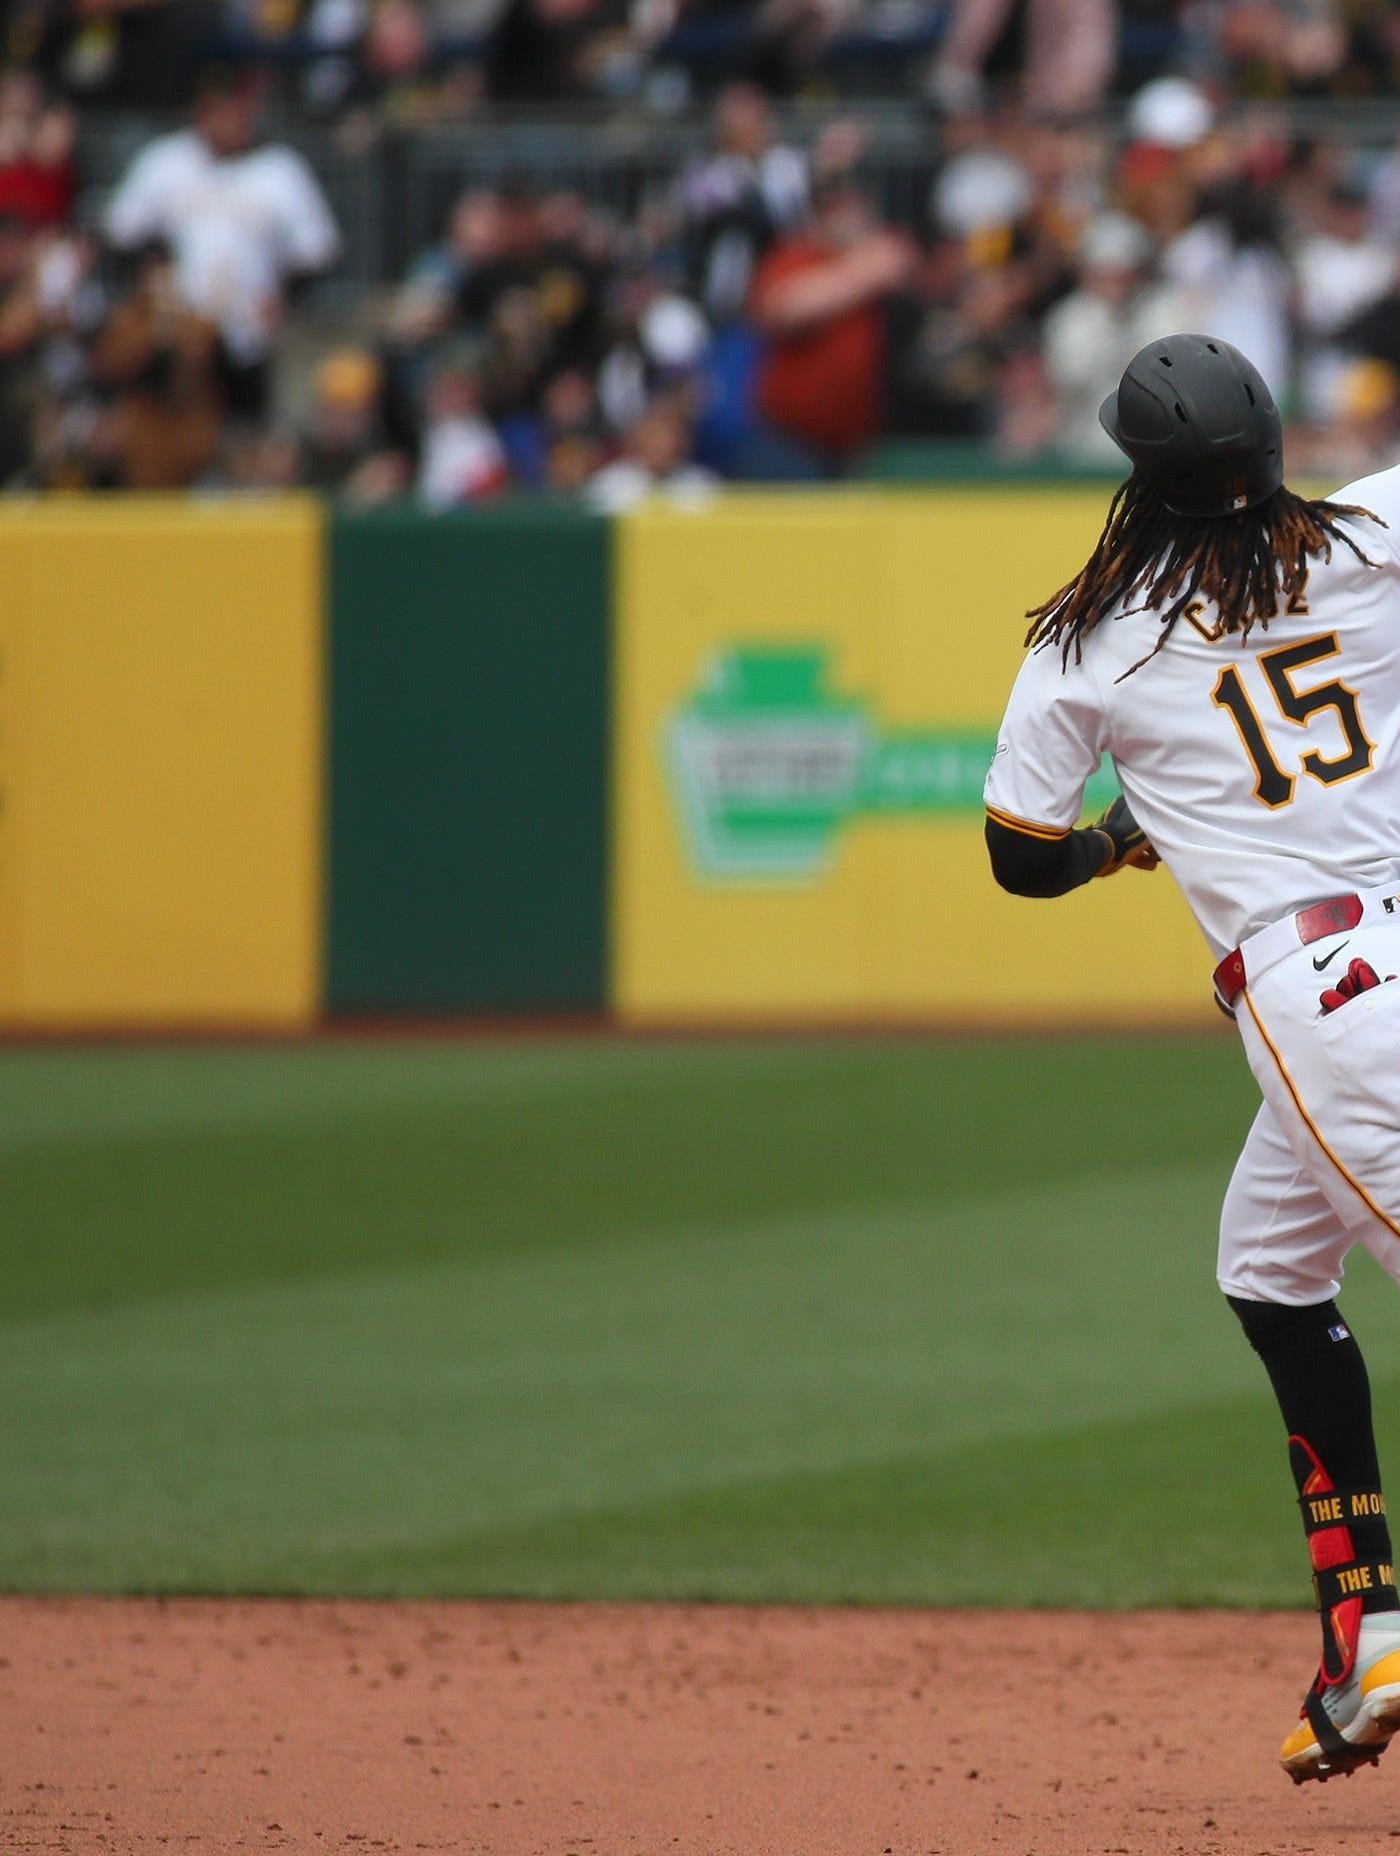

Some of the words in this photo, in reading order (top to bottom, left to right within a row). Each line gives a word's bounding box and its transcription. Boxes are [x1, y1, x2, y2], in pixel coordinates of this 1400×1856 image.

[1184, 567, 1310, 644] CZ
[1209, 630, 1378, 811] 15
[1309, 1497, 1344, 1523] THE
[1336, 1566, 1374, 1594] THE
[1378, 1564, 1396, 1586] M
